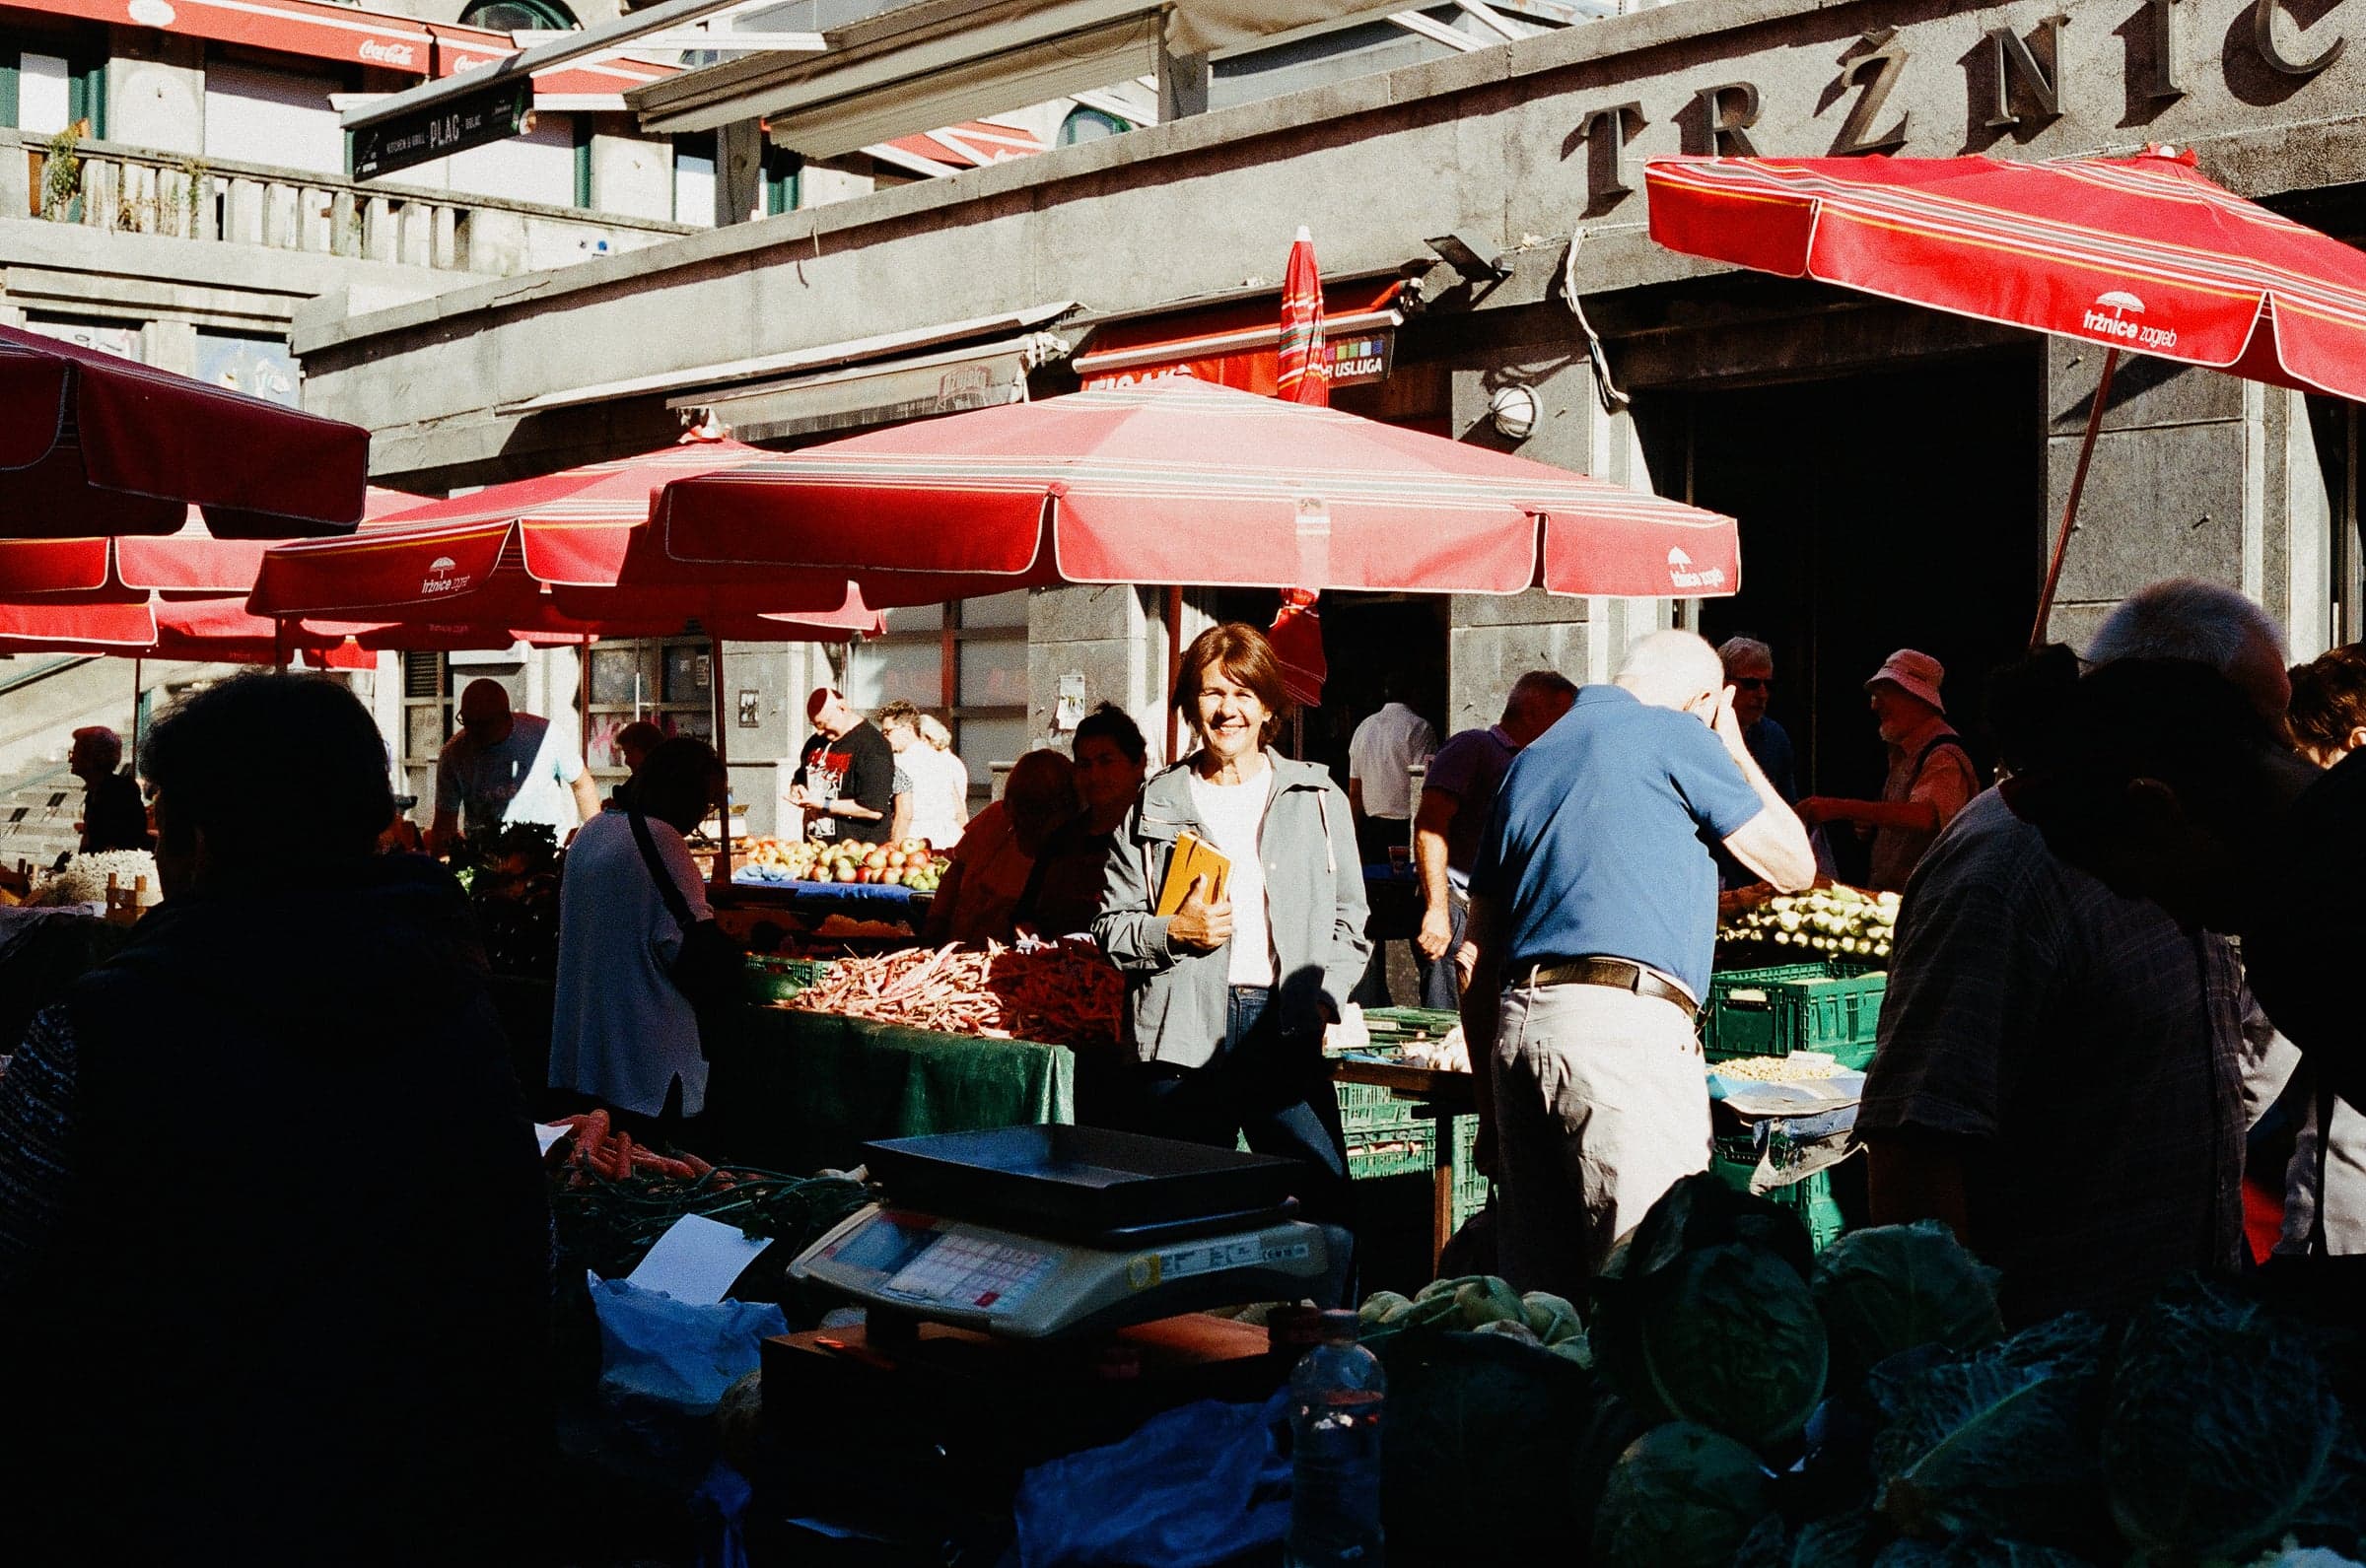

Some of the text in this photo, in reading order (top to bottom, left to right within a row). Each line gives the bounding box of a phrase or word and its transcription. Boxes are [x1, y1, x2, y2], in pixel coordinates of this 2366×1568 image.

[430, 114, 459, 147] PLAC
[2082, 308, 2178, 348] tržnice zagreb
[1335, 356, 1383, 378] USLUGA
